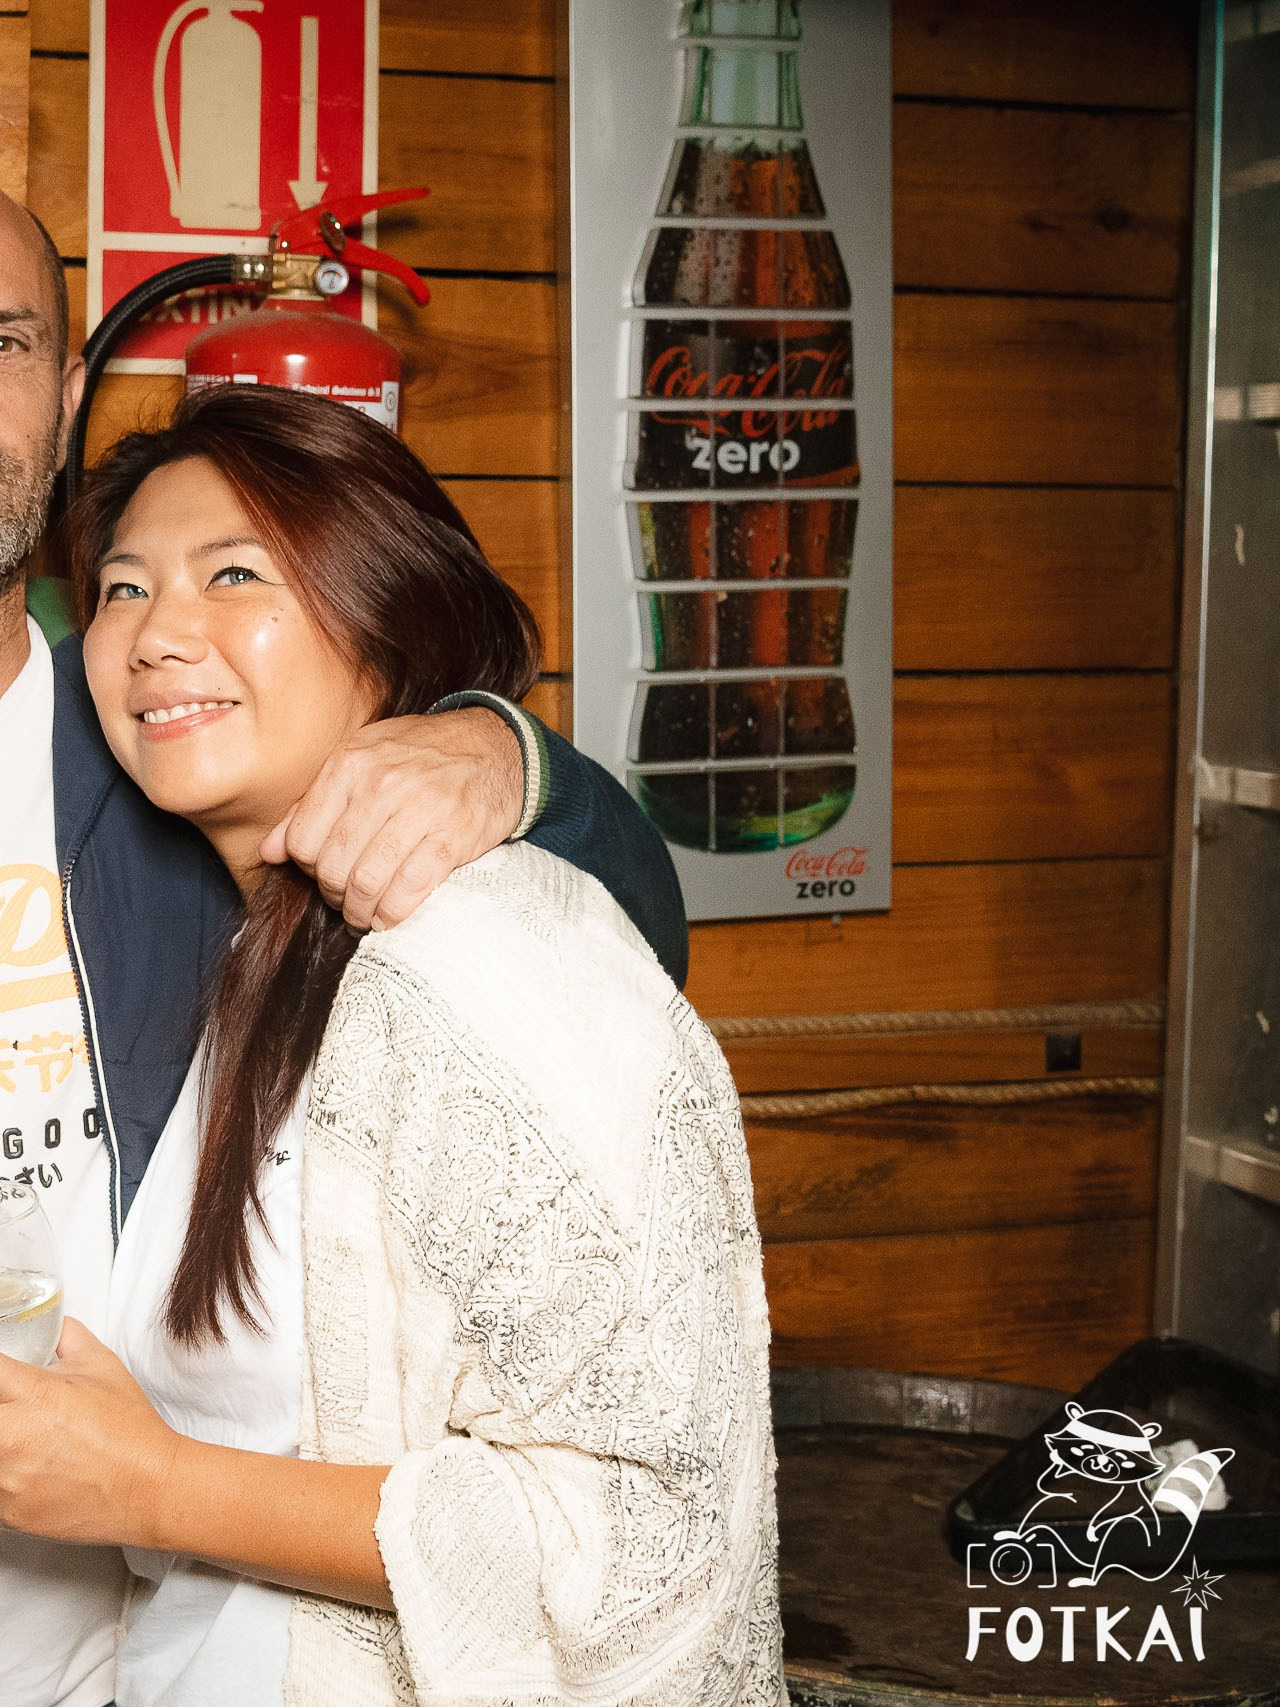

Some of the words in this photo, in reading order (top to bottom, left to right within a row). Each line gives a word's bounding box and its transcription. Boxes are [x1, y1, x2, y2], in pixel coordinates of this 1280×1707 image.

[686, 438, 801, 474] zero
[785, 847, 868, 879] Coca-Cola
[796, 877, 856, 899] zero
